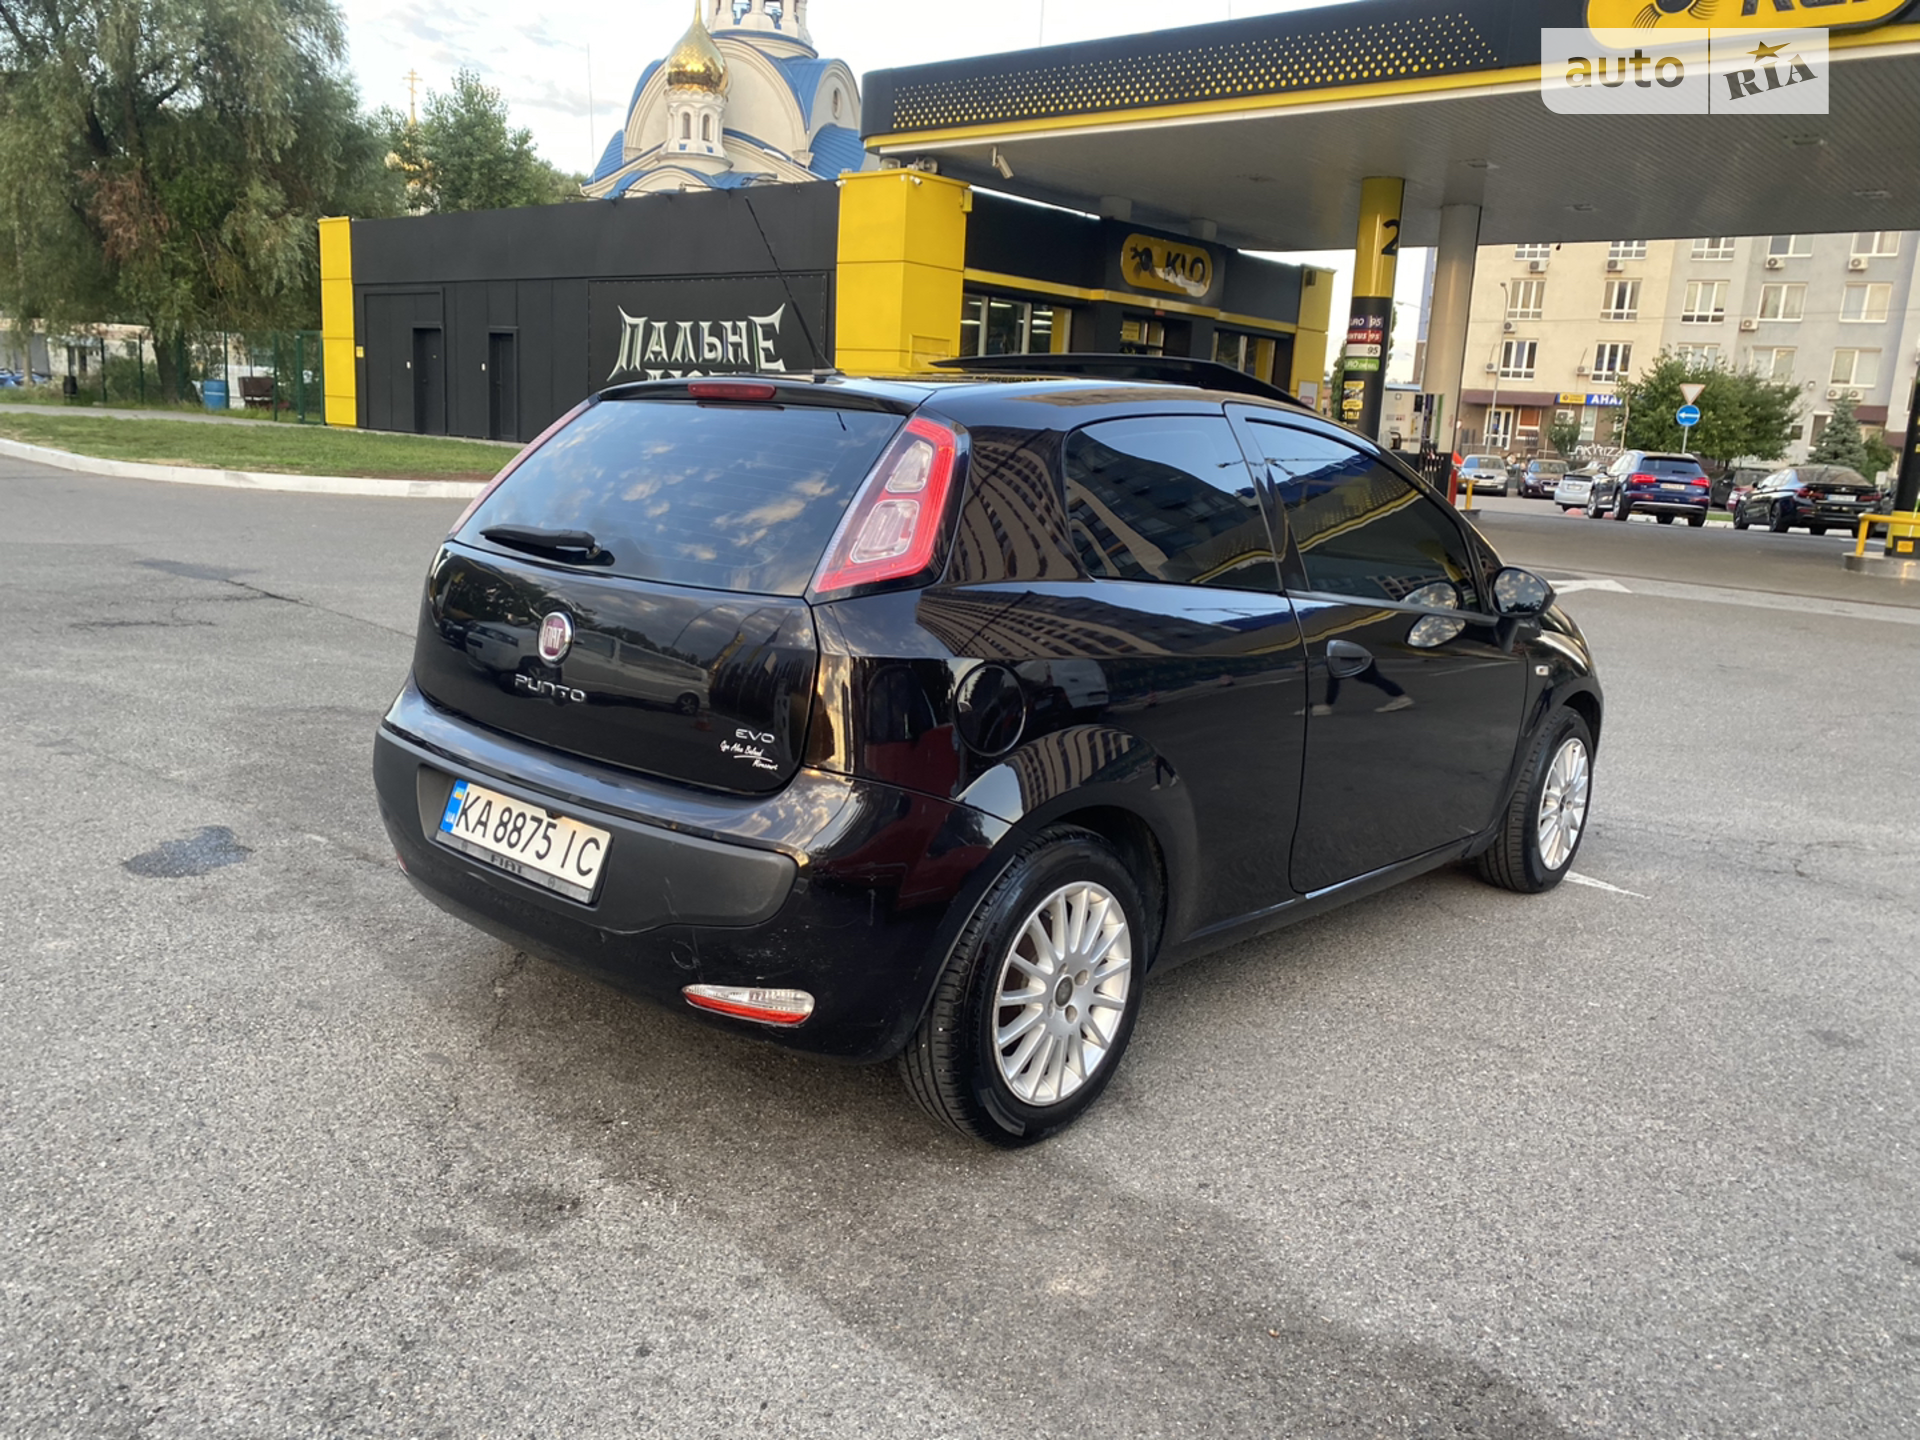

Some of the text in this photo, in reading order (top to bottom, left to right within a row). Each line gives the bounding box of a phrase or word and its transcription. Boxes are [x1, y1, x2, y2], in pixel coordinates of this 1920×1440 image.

[1381, 219, 1400, 256] 2
[1166, 251, 1206, 283] KLO
[606, 302, 786, 382] ПАЛЬНЕ
[1367, 346, 1379, 355] 95
[545, 625, 564, 650] FIAT
[514, 673, 587, 702] PUNTO
[735, 728, 775, 743] EVO
[455, 791, 601, 877] KA 8875 IC
[490, 854, 524, 875] FIAT
